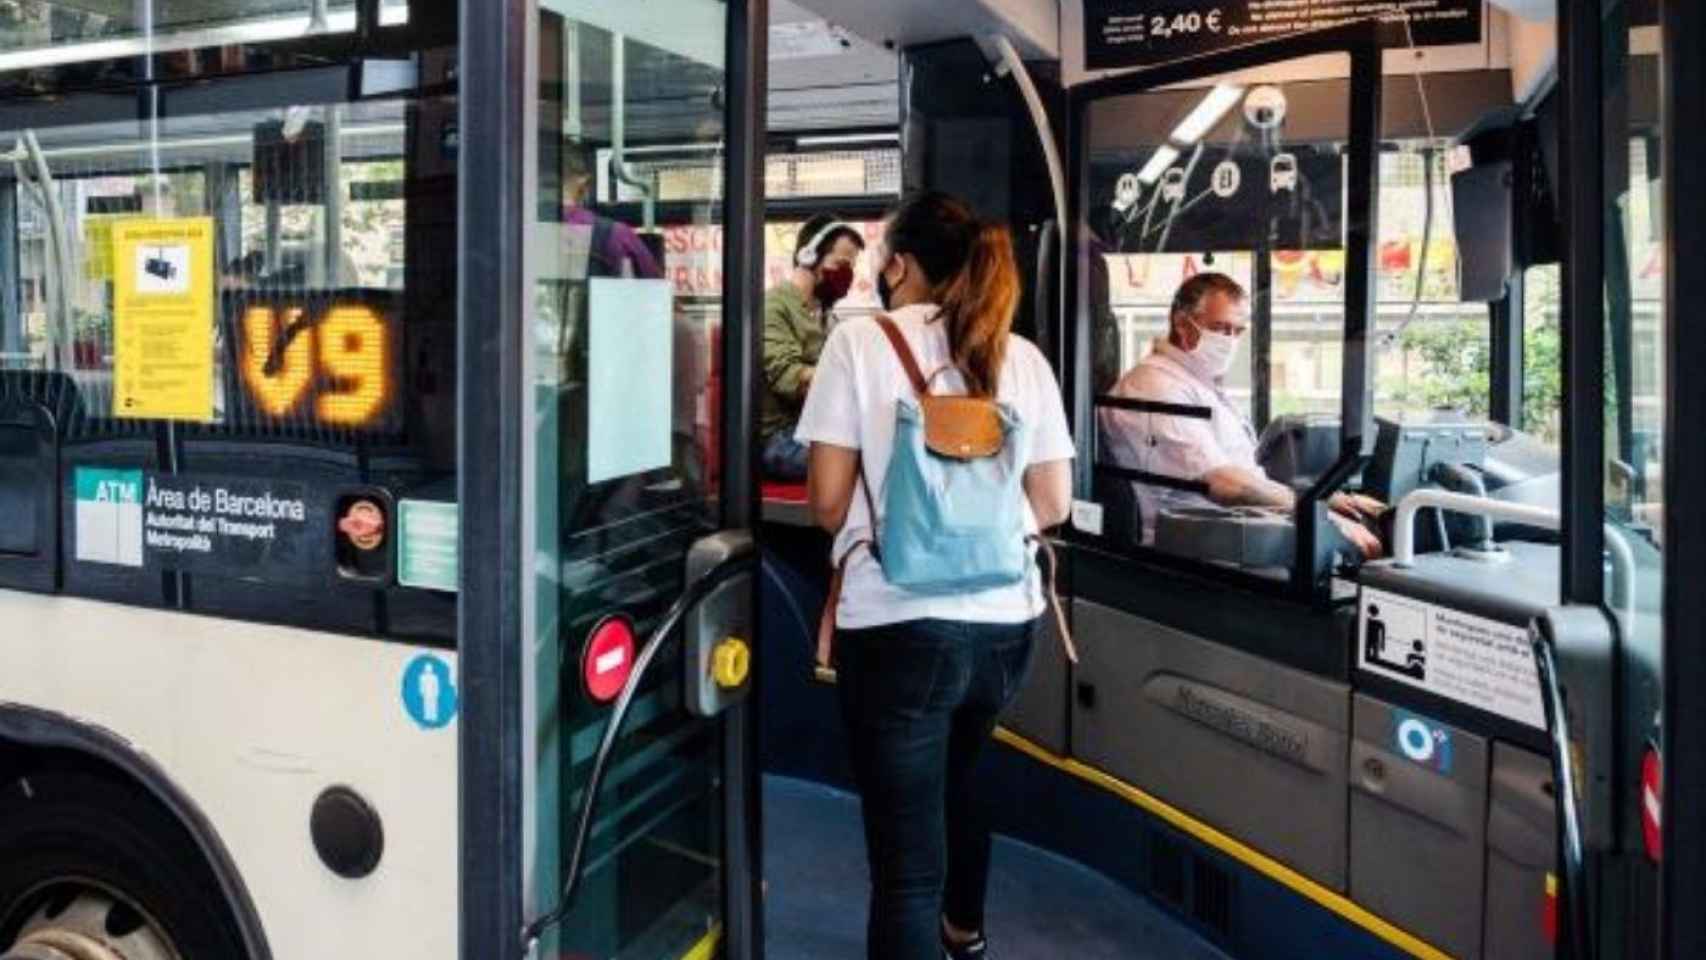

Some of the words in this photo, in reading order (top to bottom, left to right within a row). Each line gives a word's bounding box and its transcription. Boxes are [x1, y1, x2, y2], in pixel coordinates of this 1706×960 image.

[1151, 13, 1200, 38] 2,40
[1205, 8, 1222, 33] €
[240, 302, 390, 428] V9
[96, 479, 137, 503] ATM
[147, 476, 185, 509] Àrea
[188, 486, 211, 512] de
[215, 487, 305, 521] Barcelona
[146, 511, 195, 531] Autoritat
[198, 517, 216, 533] del
[217, 518, 275, 540] Transport
